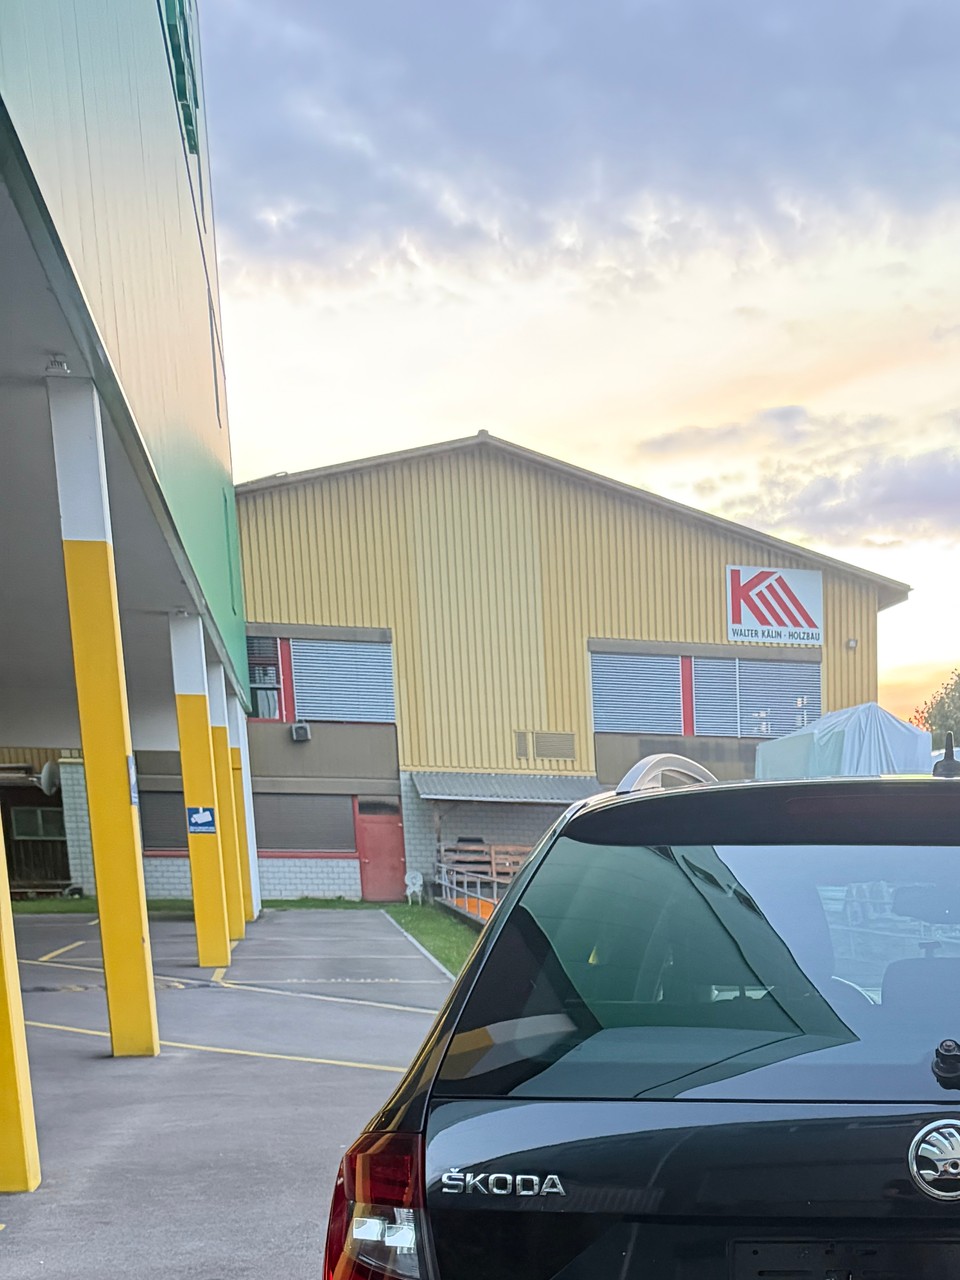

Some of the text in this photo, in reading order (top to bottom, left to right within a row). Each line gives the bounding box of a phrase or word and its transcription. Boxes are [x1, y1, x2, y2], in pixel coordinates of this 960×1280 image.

[732, 628, 759, 638] WALTER
[761, 628, 782, 639] KÄLIN
[788, 631, 820, 641] HOLZBAU
[441, 1168, 566, 1196] ŠKODA
